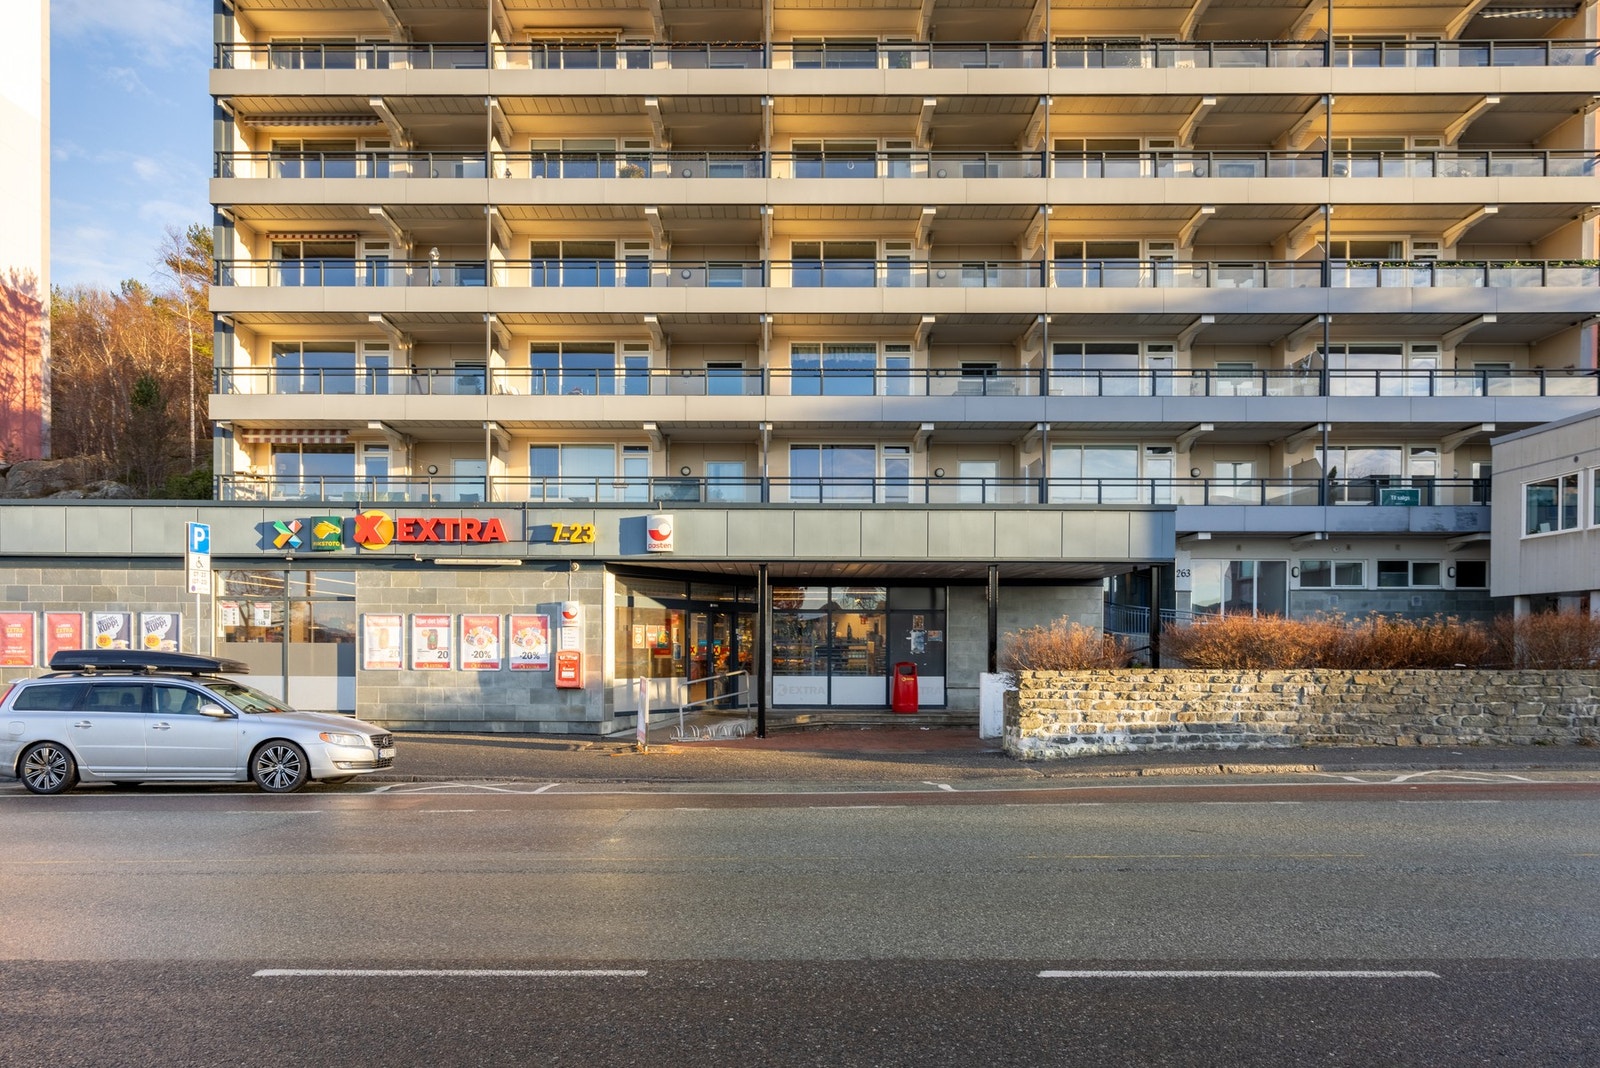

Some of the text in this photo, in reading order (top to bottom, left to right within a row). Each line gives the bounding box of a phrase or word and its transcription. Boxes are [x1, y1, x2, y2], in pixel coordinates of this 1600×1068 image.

[397, 517, 509, 543] EXTRA
[551, 522, 596, 544] 7-23
[193, 526, 206, 551] P
[1176, 568, 1191, 578] 263
[437, 650, 449, 659] 20
[471, 650, 492, 659] -20%
[520, 651, 540, 660] -20%
[788, 685, 826, 696] EXTRA
